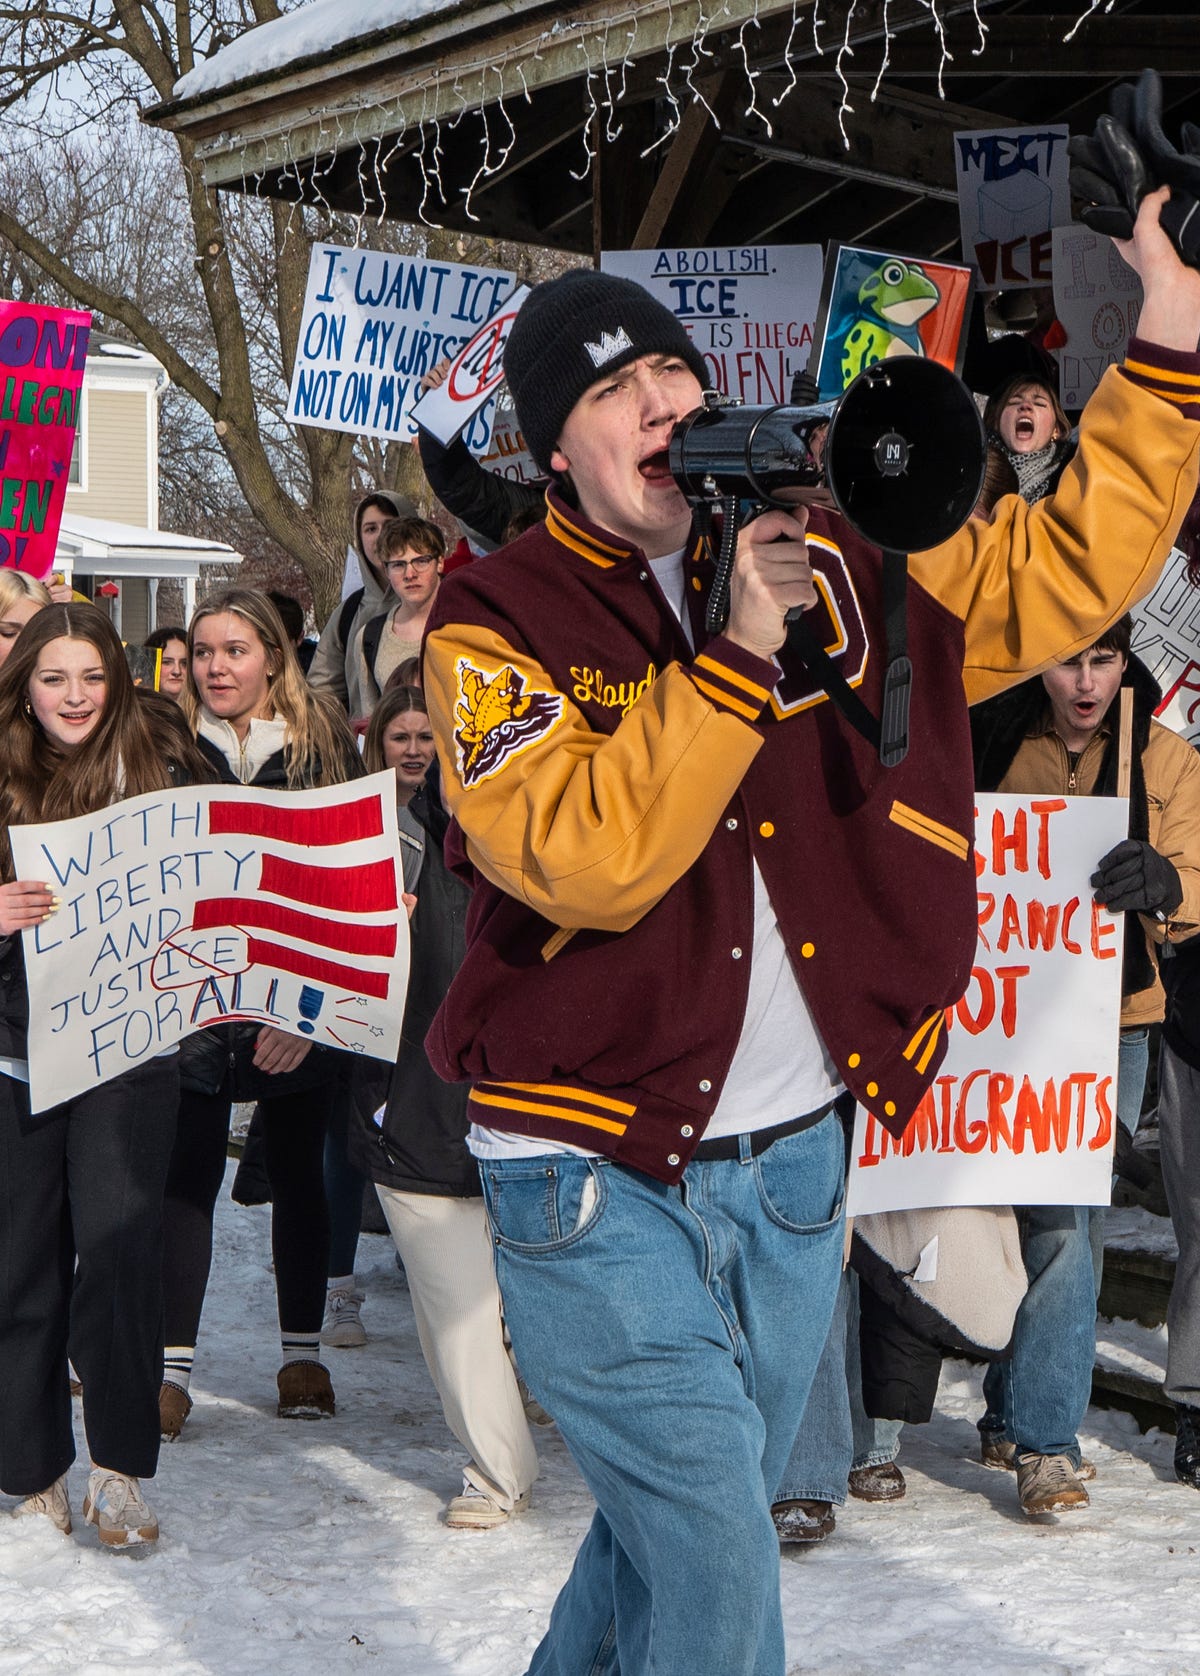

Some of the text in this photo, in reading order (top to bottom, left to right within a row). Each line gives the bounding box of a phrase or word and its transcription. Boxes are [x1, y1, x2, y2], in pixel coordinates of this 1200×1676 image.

[316, 251, 509, 324] I WANT ICE
[975, 232, 1053, 284] ICE
[304, 312, 465, 376] ON MY WRIS
[709, 323, 732, 348] IS
[743, 322, 815, 350] ILLEGA
[294, 370, 342, 420] NOT
[340, 371, 372, 425] ON
[373, 373, 410, 432] MY
[570, 664, 656, 718] Lloyd
[41, 802, 200, 886] WITH
[35, 850, 256, 954] LIBERTY
[976, 892, 1116, 960] RANCE
[89, 908, 182, 977] AND
[50, 936, 240, 1032] JUSTICE
[948, 965, 1030, 1039] OT
[88, 991, 182, 1077] FOR
